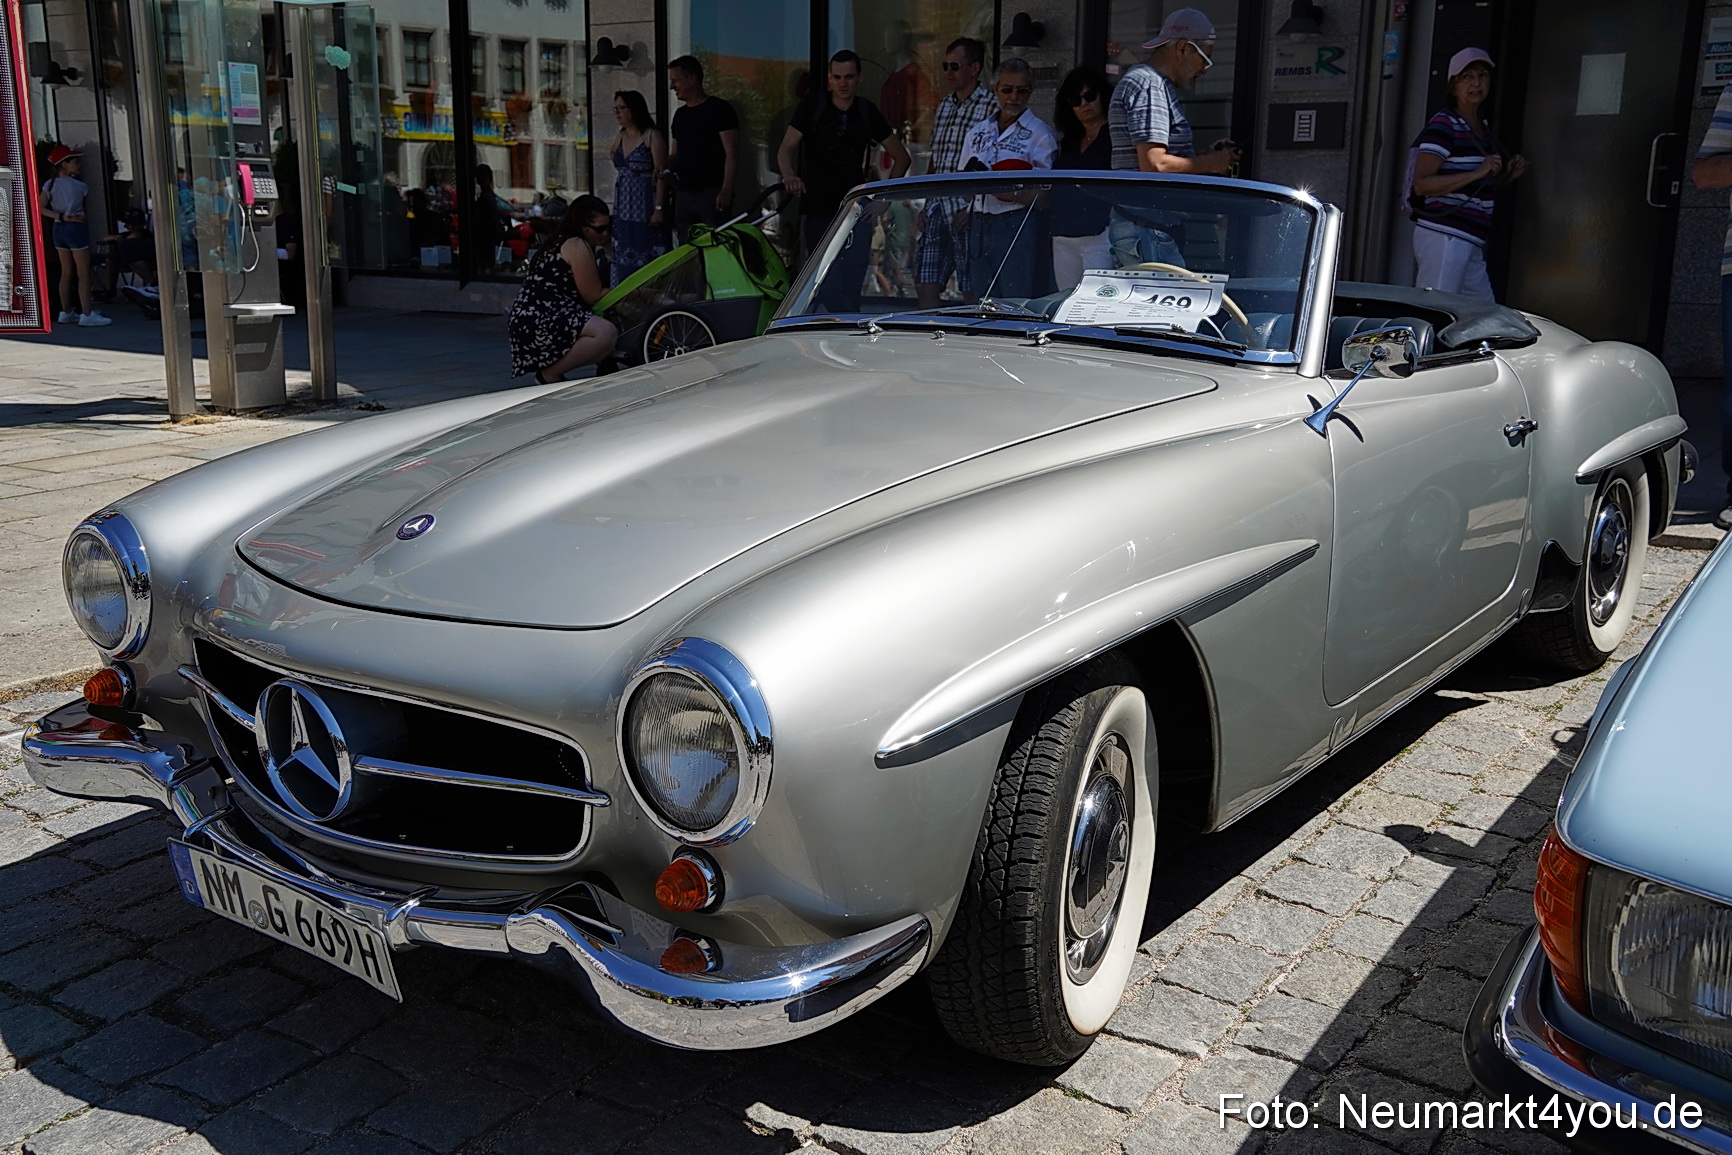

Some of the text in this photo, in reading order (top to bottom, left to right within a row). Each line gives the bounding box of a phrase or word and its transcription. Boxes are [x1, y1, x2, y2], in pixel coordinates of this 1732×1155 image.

[1274, 66, 1312, 75] REMBS
[1143, 294, 1192, 309] 469
[186, 879, 196, 894] D
[200, 858, 384, 985] NM G 669H
